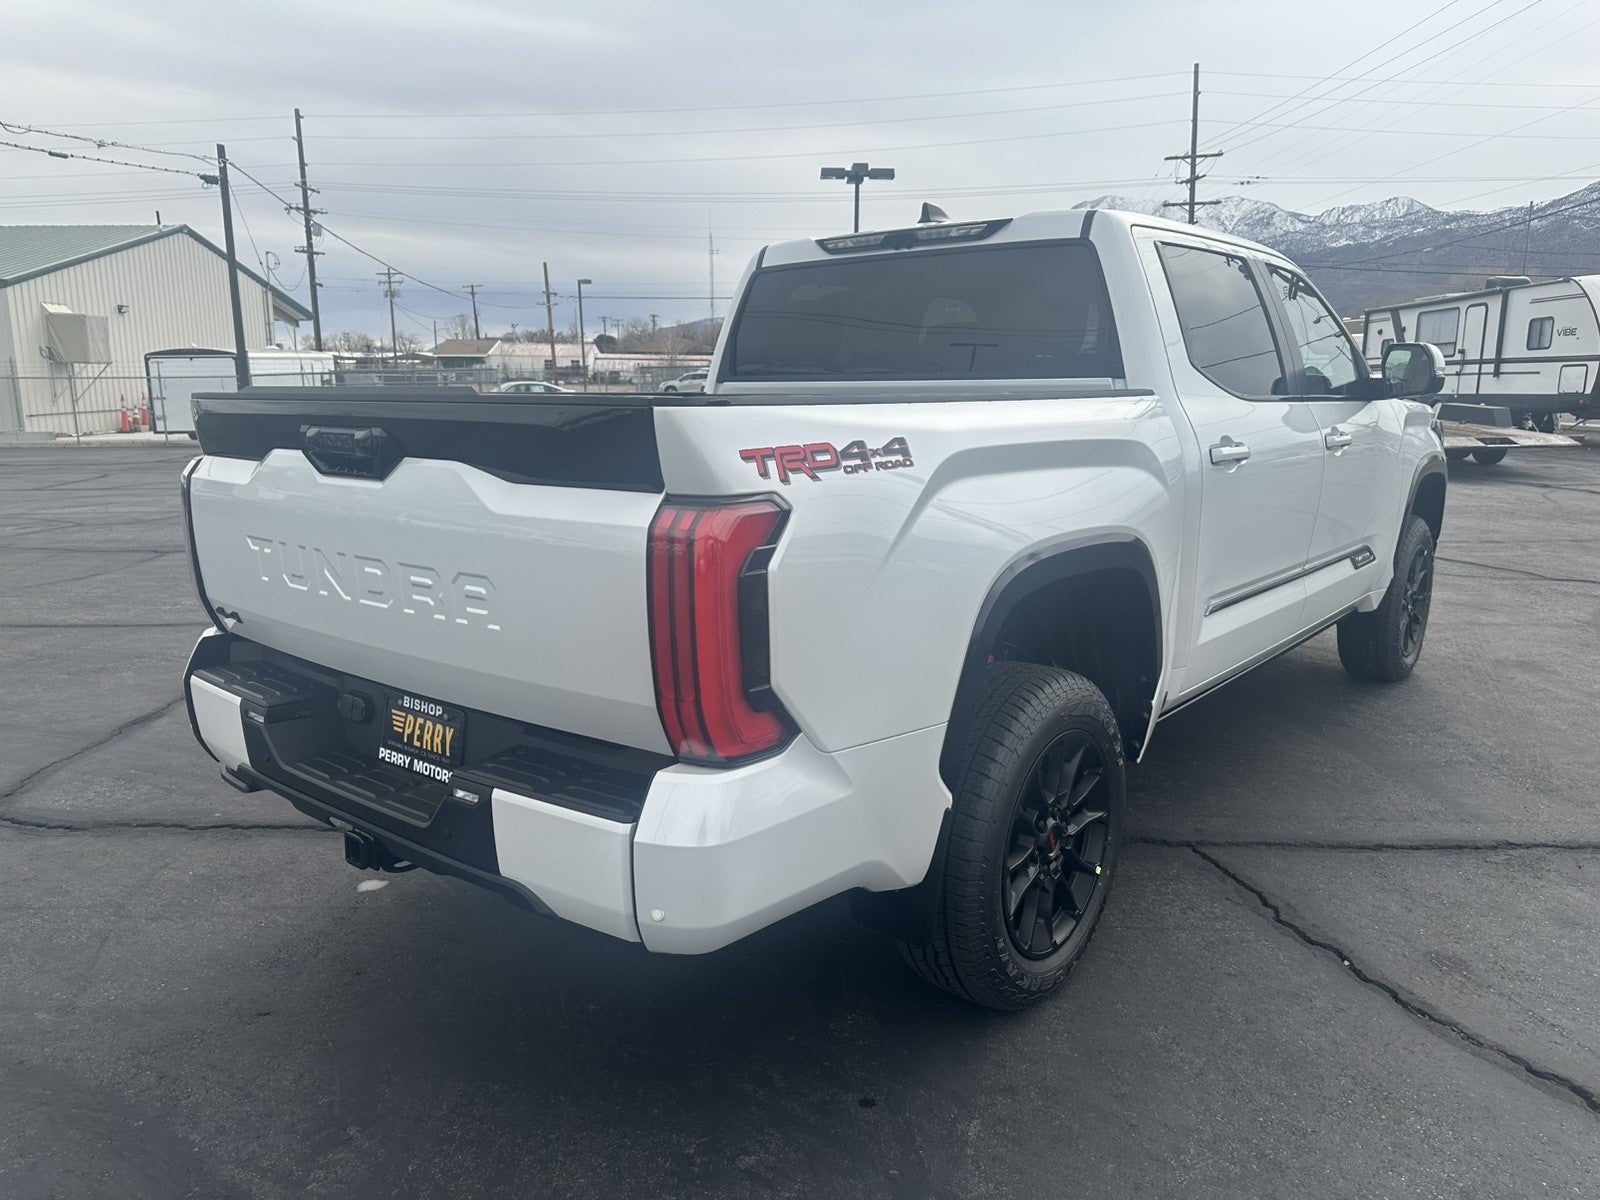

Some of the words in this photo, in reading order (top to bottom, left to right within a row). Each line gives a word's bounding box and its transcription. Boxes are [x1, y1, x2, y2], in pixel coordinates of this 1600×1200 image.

[1556, 327, 1578, 337] VIBE
[738, 441, 842, 485] TRD
[843, 462, 874, 475] OFF
[874, 457, 915, 472] ROAD
[246, 534, 501, 631] TUNDRA
[403, 695, 443, 717] BISHOP
[403, 713, 455, 757] PERRY
[378, 746, 411, 769] PERRY
